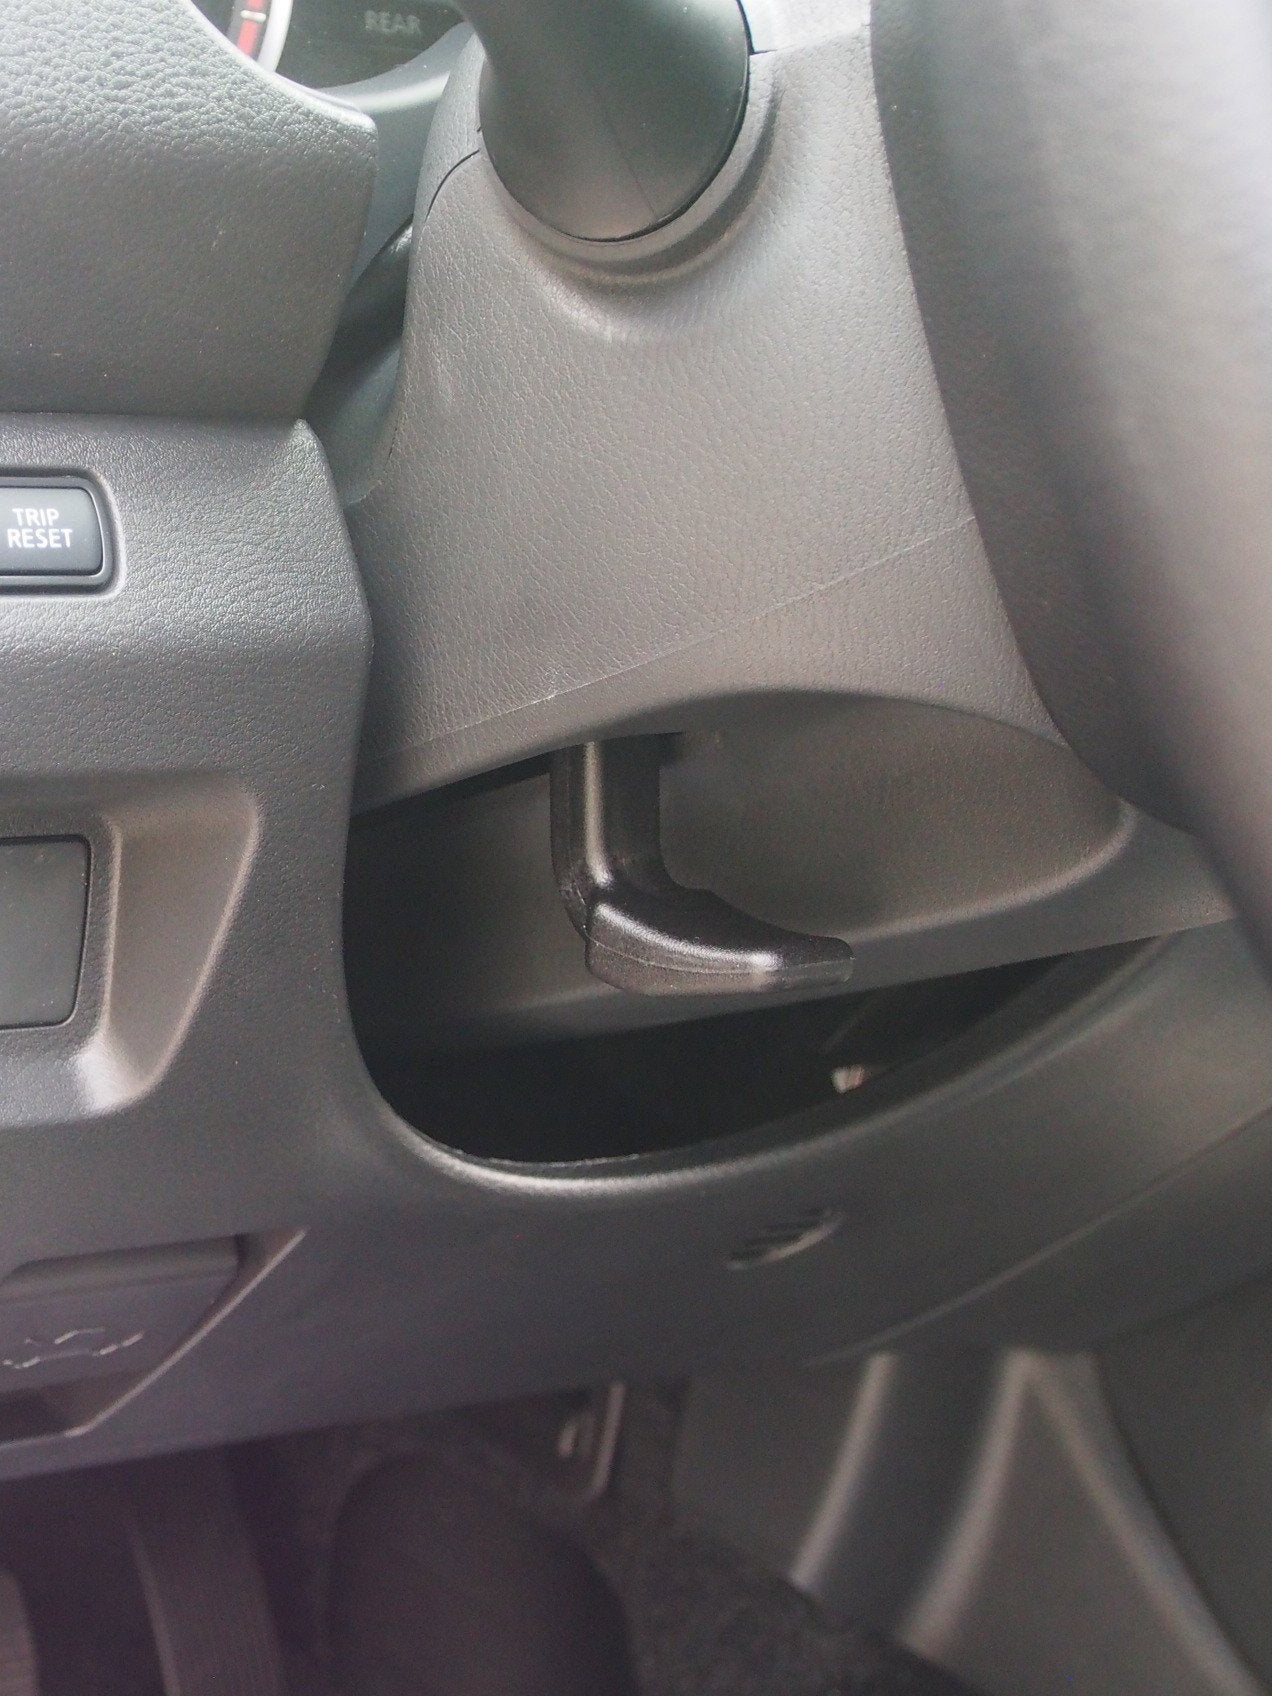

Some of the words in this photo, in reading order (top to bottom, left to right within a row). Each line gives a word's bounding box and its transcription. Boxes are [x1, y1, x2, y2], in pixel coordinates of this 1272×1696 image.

[364, 10, 421, 34] REAR
[12, 508, 59, 526] TRIP
[7, 528, 73, 548] RESET
